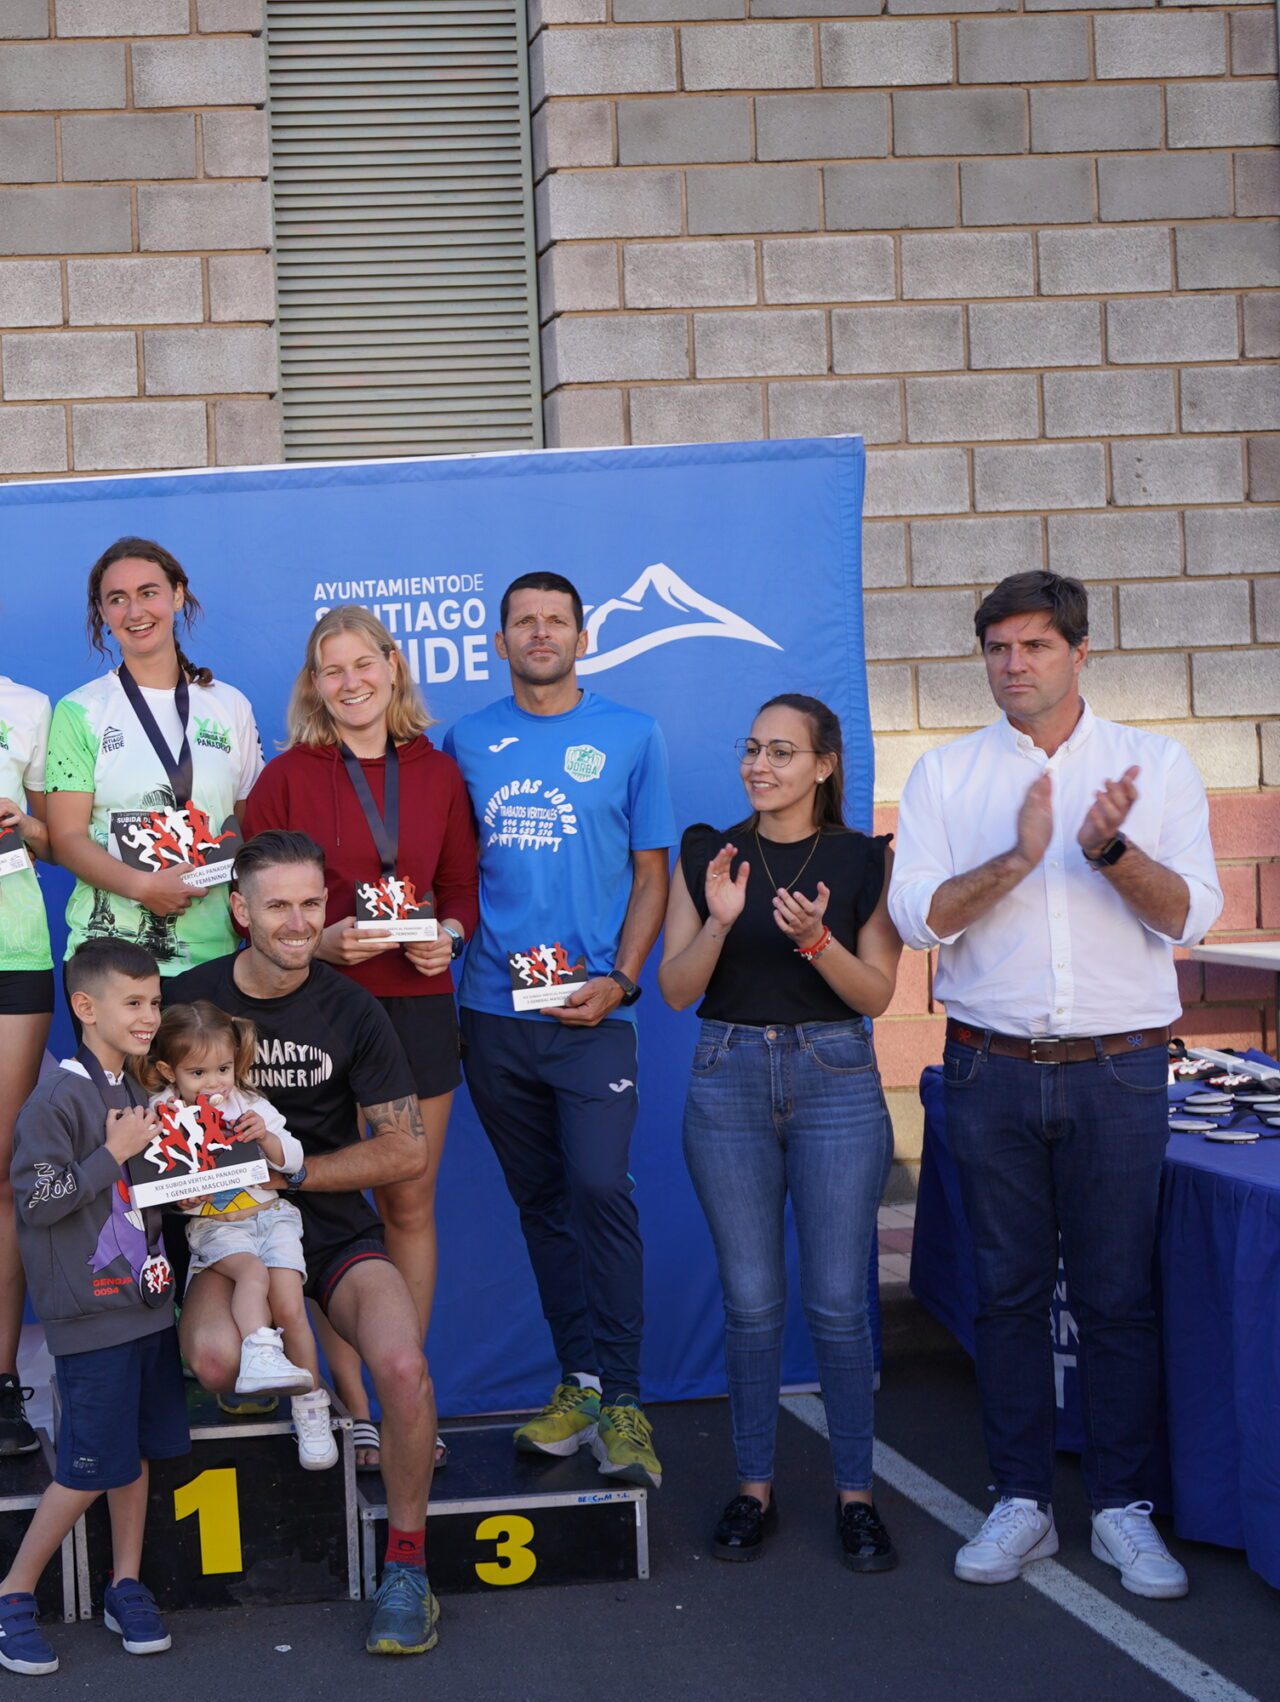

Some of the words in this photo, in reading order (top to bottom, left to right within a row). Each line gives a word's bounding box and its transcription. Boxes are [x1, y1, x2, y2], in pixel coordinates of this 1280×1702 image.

[315, 598, 486, 634] STIAGO
[397, 634, 490, 685] IDE
[484, 778, 543, 828] PINTURAS
[544, 787, 578, 835] JORBA
[500, 805, 526, 818] TRABAJOS
[527, 806, 558, 821] VERTICALES
[116, 816, 142, 824] SUBIDA
[195, 872, 228, 885] FEMENINO
[253, 1038, 310, 1066] NARY
[247, 1067, 309, 1088] UNNER
[165, 1180, 187, 1190] SUBIDA
[187, 1174, 215, 1185] VERTICAL
[215, 1168, 248, 1179] PANADERO
[170, 1187, 201, 1198] GENERAL
[201, 1178, 241, 1190] MASCULINO
[93, 1287, 119, 1297] 0094
[174, 1467, 243, 1575] 1
[474, 1514, 537, 1586] 3
